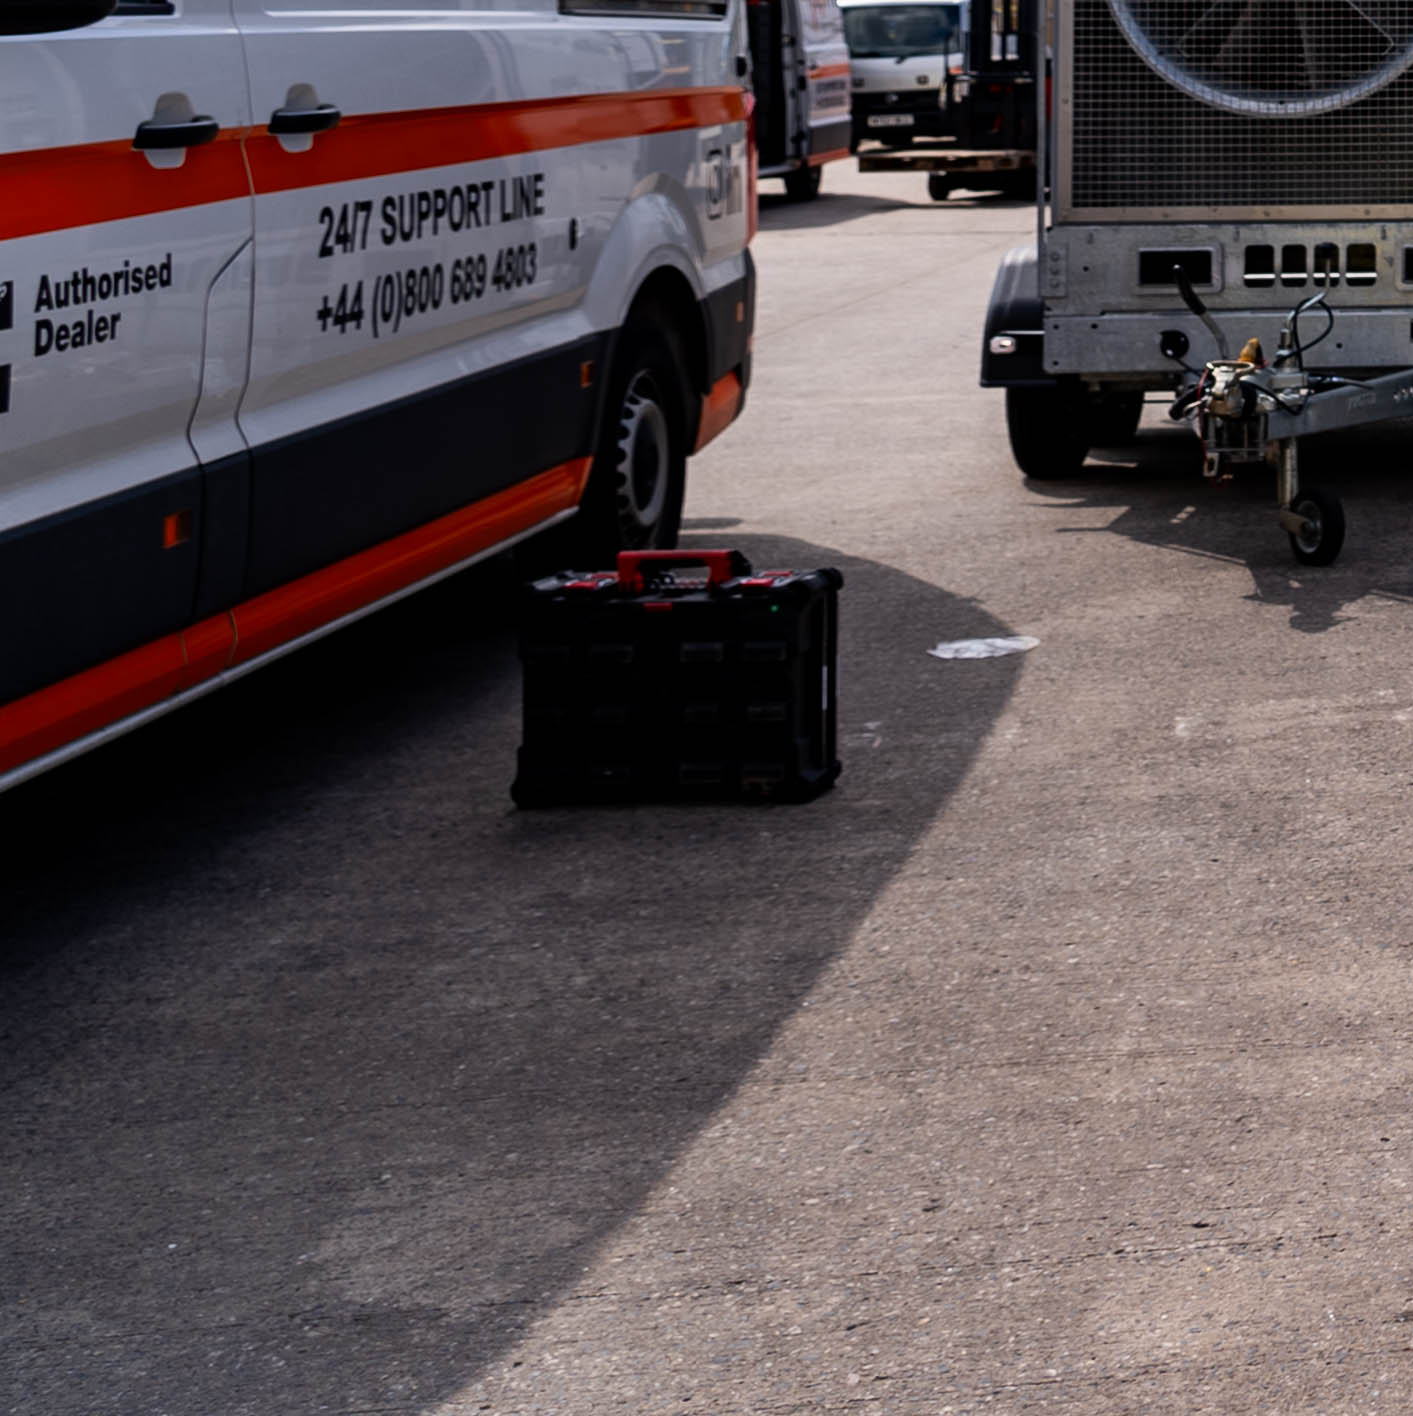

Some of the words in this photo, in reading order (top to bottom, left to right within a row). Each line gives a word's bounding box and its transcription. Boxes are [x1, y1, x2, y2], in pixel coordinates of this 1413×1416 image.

[318, 200, 373, 259] 24/7
[380, 180, 494, 246] SUPPORT
[500, 173, 545, 223] LINE
[34, 252, 172, 314] Authorised
[317, 279, 364, 334] +44
[371, 263, 445, 338] (0)800
[450, 253, 488, 305] 689
[491, 242, 538, 293] 4803
[34, 309, 121, 358] Dealer
